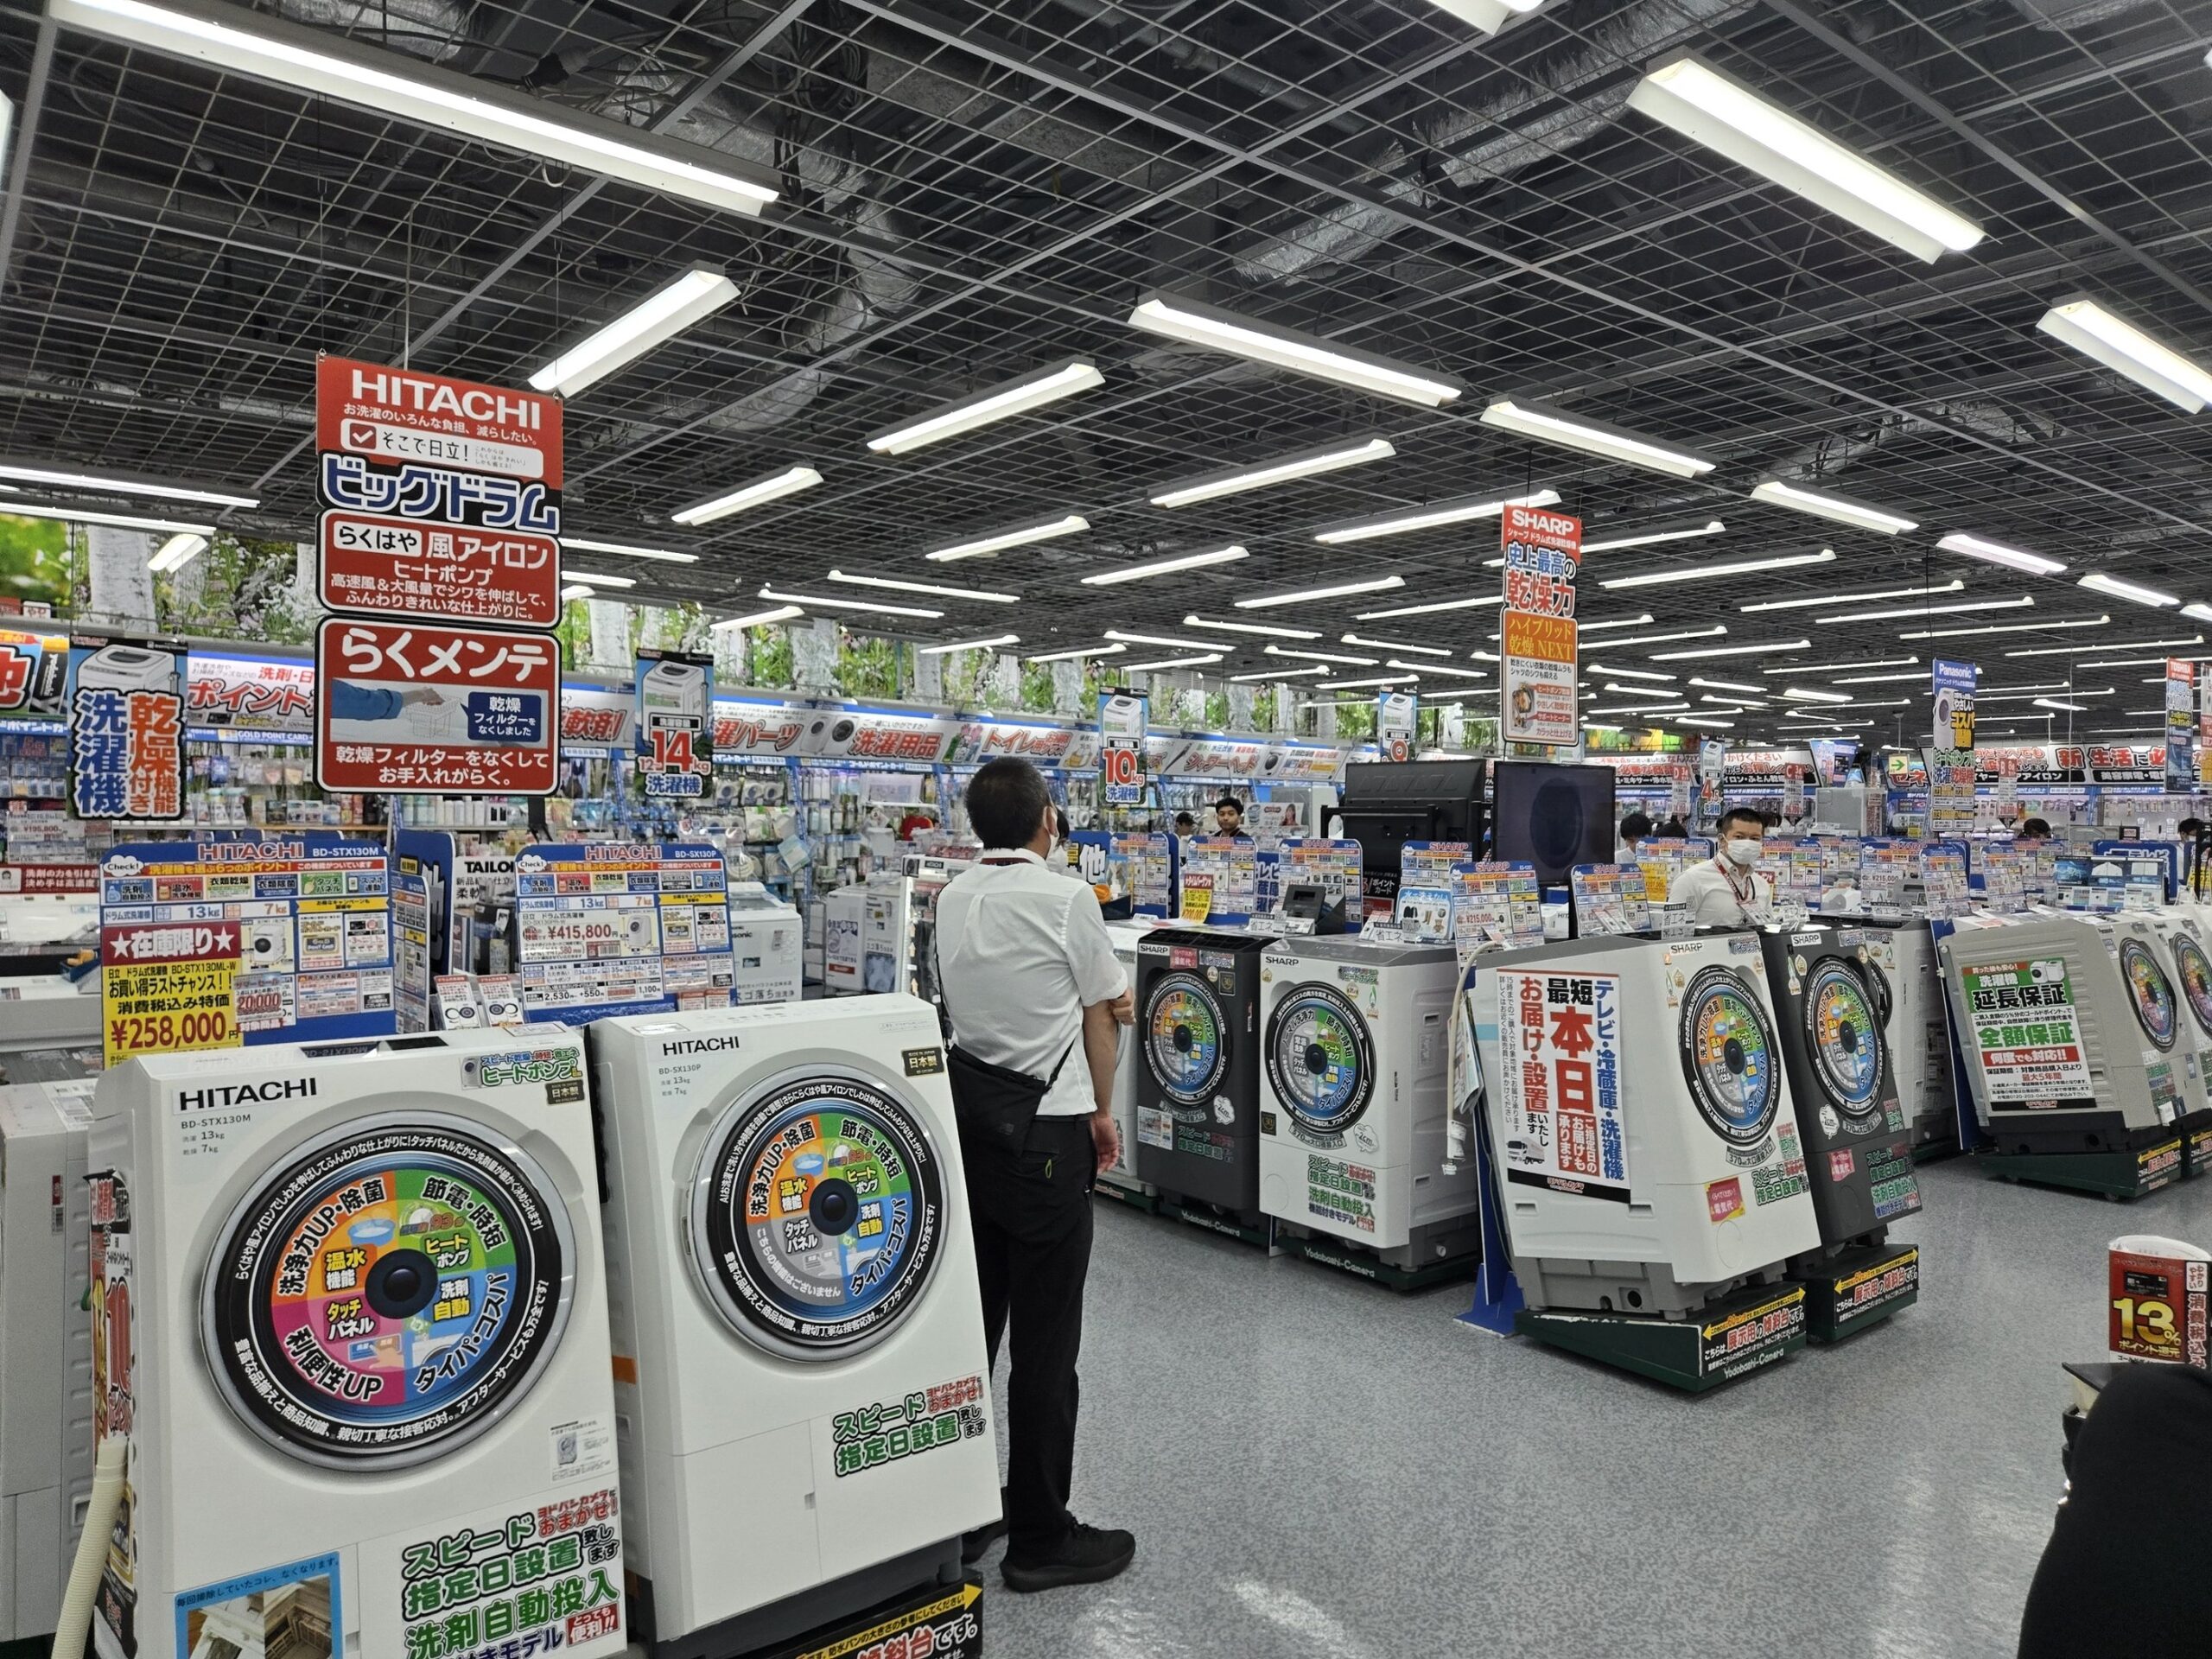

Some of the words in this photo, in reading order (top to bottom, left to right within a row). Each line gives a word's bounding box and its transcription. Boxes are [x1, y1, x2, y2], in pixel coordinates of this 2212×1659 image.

[353, 369, 540, 429] HITACHI
[344, 403, 537, 445] お洗濯のいろんな負担、減らしたい。
[323, 454, 559, 533] ビッグドラム
[1512, 509, 1573, 535] SHARP
[339, 526, 416, 552] らくはや
[427, 532, 548, 569] 風アイロン
[1509, 543, 1576, 579] 史上最高の
[394, 561, 493, 586] ヒートポンプ
[1507, 570, 1575, 617] 乾燥力
[346, 591, 533, 620] ふんわりきれいな仕上がりに。
[1510, 618, 1572, 639] ハイブリッド
[342, 627, 548, 682] らくメンテ
[1510, 634, 1534, 655] 乾燥
[1538, 640, 1573, 660] NEXT
[1939, 664, 1972, 678] Panasonic
[489, 697, 521, 712] 乾燥
[474, 713, 536, 727] フィルターを
[479, 725, 531, 736] なくしました
[78, 692, 128, 814] 洗濯機
[652, 730, 692, 772] 14
[850, 728, 943, 760] 洗濯用品
[336, 747, 549, 768] 乾燥フィルターをなくして
[1103, 748, 1138, 785] 10
[378, 766, 510, 785] お手入れがらく。
[646, 774, 702, 796] 洗濯機
[1105, 786, 1141, 803] 洗濯機
[198, 842, 304, 861] HITACHI
[312, 847, 378, 857] BD-STX130M
[585, 845, 661, 861] HITACHI
[1429, 842, 1468, 851] SHARP
[1476, 862, 1510, 872] SHARP
[105, 910, 151, 920] ドラム式洗濯機
[130, 927, 213, 960] 在庫限り
[548, 925, 611, 940] ¥415,800
[1793, 935, 1821, 944] SHARP
[1141, 944, 1168, 953] SHARP
[1670, 943, 1703, 953] SHARP
[1265, 956, 1299, 966] SHARP
[108, 969, 120, 978] 日立
[1979, 973, 2018, 988] 洗濯機
[1548, 978, 1593, 1005] 最短
[1972, 983, 2067, 1011] 延長保証
[118, 994, 230, 1014] 消費税込み特価
[111, 1012, 226, 1050] ¥258,000
[1978, 1022, 2075, 1048] 全額保証
[663, 1036, 740, 1056] HITACHI
[1520, 976, 1549, 1113] お届け・設置
[658, 1064, 702, 1075] BD-SX130P
[908, 1055, 939, 1070] 日本製
[1550, 1006, 1594, 1115] 本日
[482, 1059, 577, 1086] ヒートポンプ
[1593, 981, 1624, 1181] テレビ・冷蔵庫・洗濯機
[179, 1077, 317, 1111] HITACHI
[181, 1114, 251, 1129] BD-STX130M
[1527, 1113, 1537, 1134] ます
[1538, 1114, 1549, 1147] いたし
[840, 1119, 903, 1180] 節電・時短
[749, 1120, 816, 1216] 洗浄力UP・除菌
[847, 1167, 876, 1183] ヒート
[1308, 1154, 1348, 1175] スピード
[780, 1179, 807, 1196] 温水
[855, 1179, 878, 1194] ポンプ
[423, 1176, 506, 1251] 節電・時短
[861, 1202, 880, 1219] 洗剤
[1308, 1186, 1376, 1219] 洗剤自動投入
[278, 1179, 386, 1296] 洗浄力UP・除菌
[785, 1218, 808, 1236] タッチ
[858, 1219, 883, 1237] 自動
[425, 1235, 468, 1255] ヒート
[787, 1233, 818, 1254] パネル
[850, 1198, 907, 1294] タイパ・コスパ
[325, 1249, 365, 1270] 温水
[436, 1249, 471, 1268] ポンプ
[1305, 1246, 1375, 1278] Yodobashi-Camera
[326, 1270, 357, 1291] 機能
[441, 1280, 469, 1298] 洗剤
[327, 1300, 361, 1319] タッチ
[434, 1298, 471, 1321] 自動
[328, 1317, 374, 1341] パネル
[2113, 1298, 2181, 1345] 13%
[415, 1273, 508, 1394] タイパ・コスパ
[285, 1326, 383, 1402] 利便性UP
[1723, 1348, 1784, 1379] Yodobashi-Camera
[834, 1393, 925, 1441] スピード
[836, 1411, 961, 1478] 指定日設置
[403, 1513, 534, 1579] スピード
[584, 1524, 613, 1547] 致し
[589, 1541, 618, 1564] ます
[404, 1535, 582, 1620] 指定日設置
[405, 1568, 619, 1659] 洗剤自動投入
